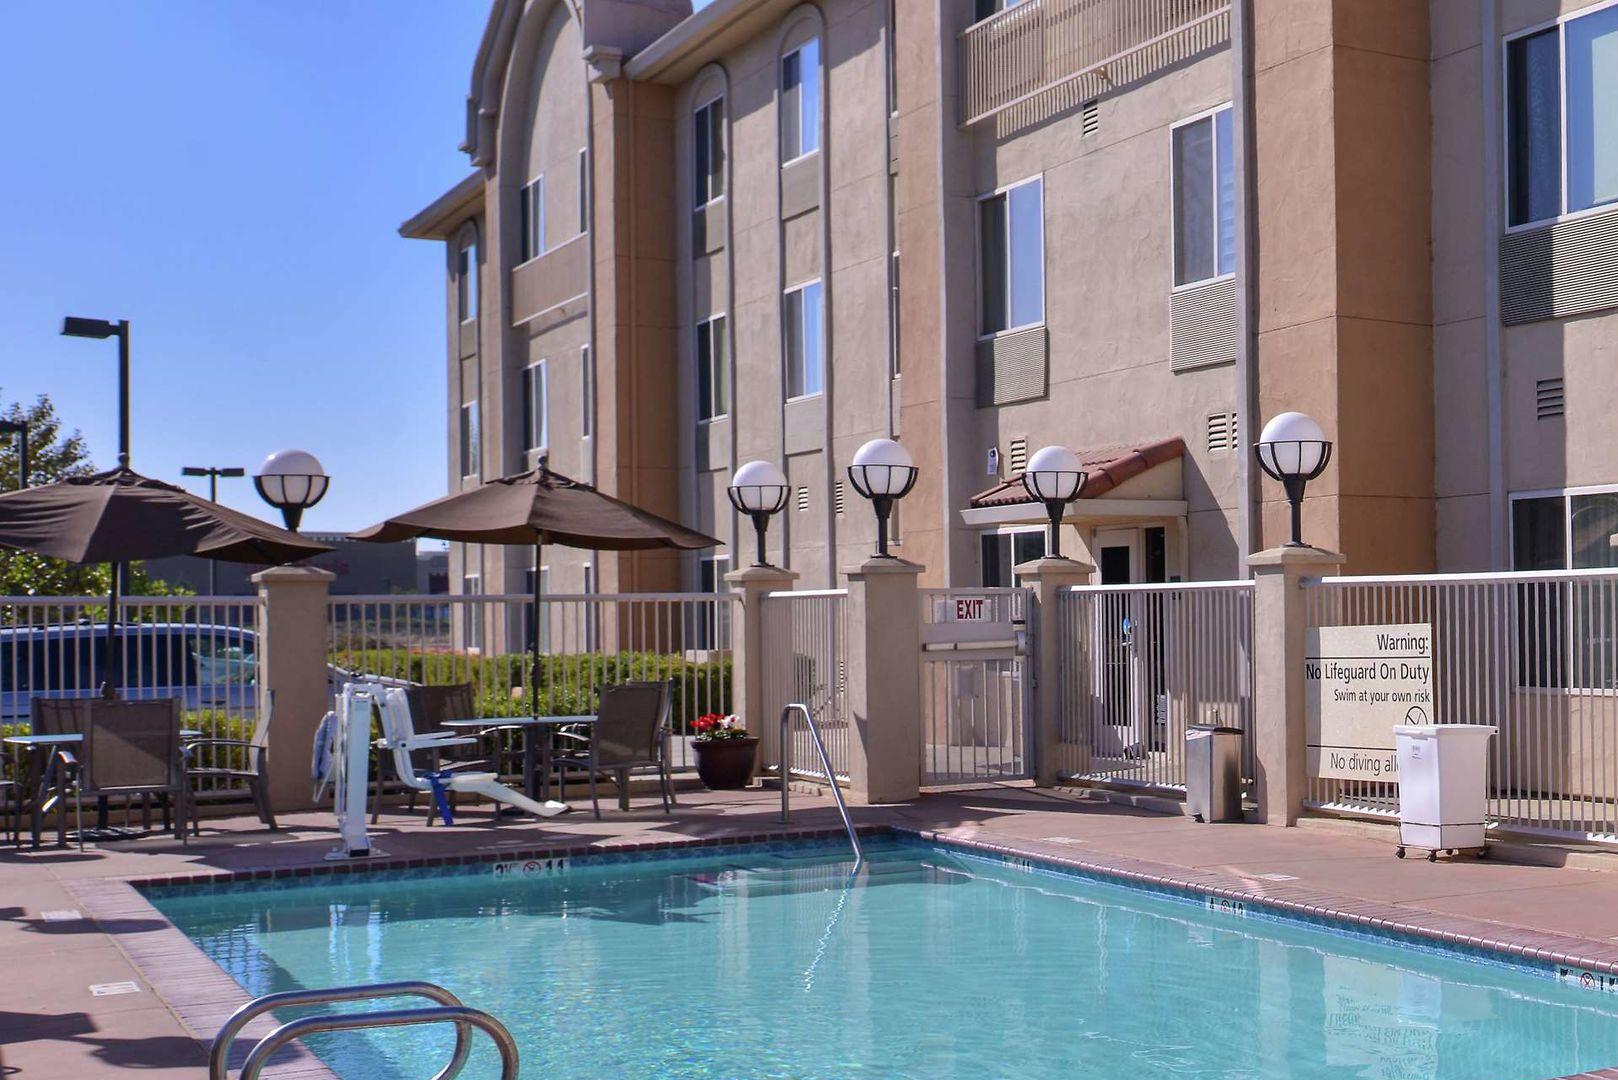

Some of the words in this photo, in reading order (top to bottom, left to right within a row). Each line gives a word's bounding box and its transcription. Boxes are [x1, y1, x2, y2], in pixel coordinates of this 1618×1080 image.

[956, 599, 983, 619] EXIT
[1376, 633, 1429, 655] Warning:
[1306, 664, 1322, 679] No
[1325, 662, 1376, 684] Lifeguard
[1380, 664, 1397, 680] On
[1400, 663, 1430, 684] Duty
[1334, 688, 1356, 702] Swim
[1359, 690, 1368, 701] at
[1370, 691, 1389, 705] your
[1391, 690, 1412, 702] own
[1414, 689, 1430, 703] risk
[1330, 753, 1346, 769] No
[1348, 753, 1381, 776] diving
[1384, 755, 1399, 772] all
